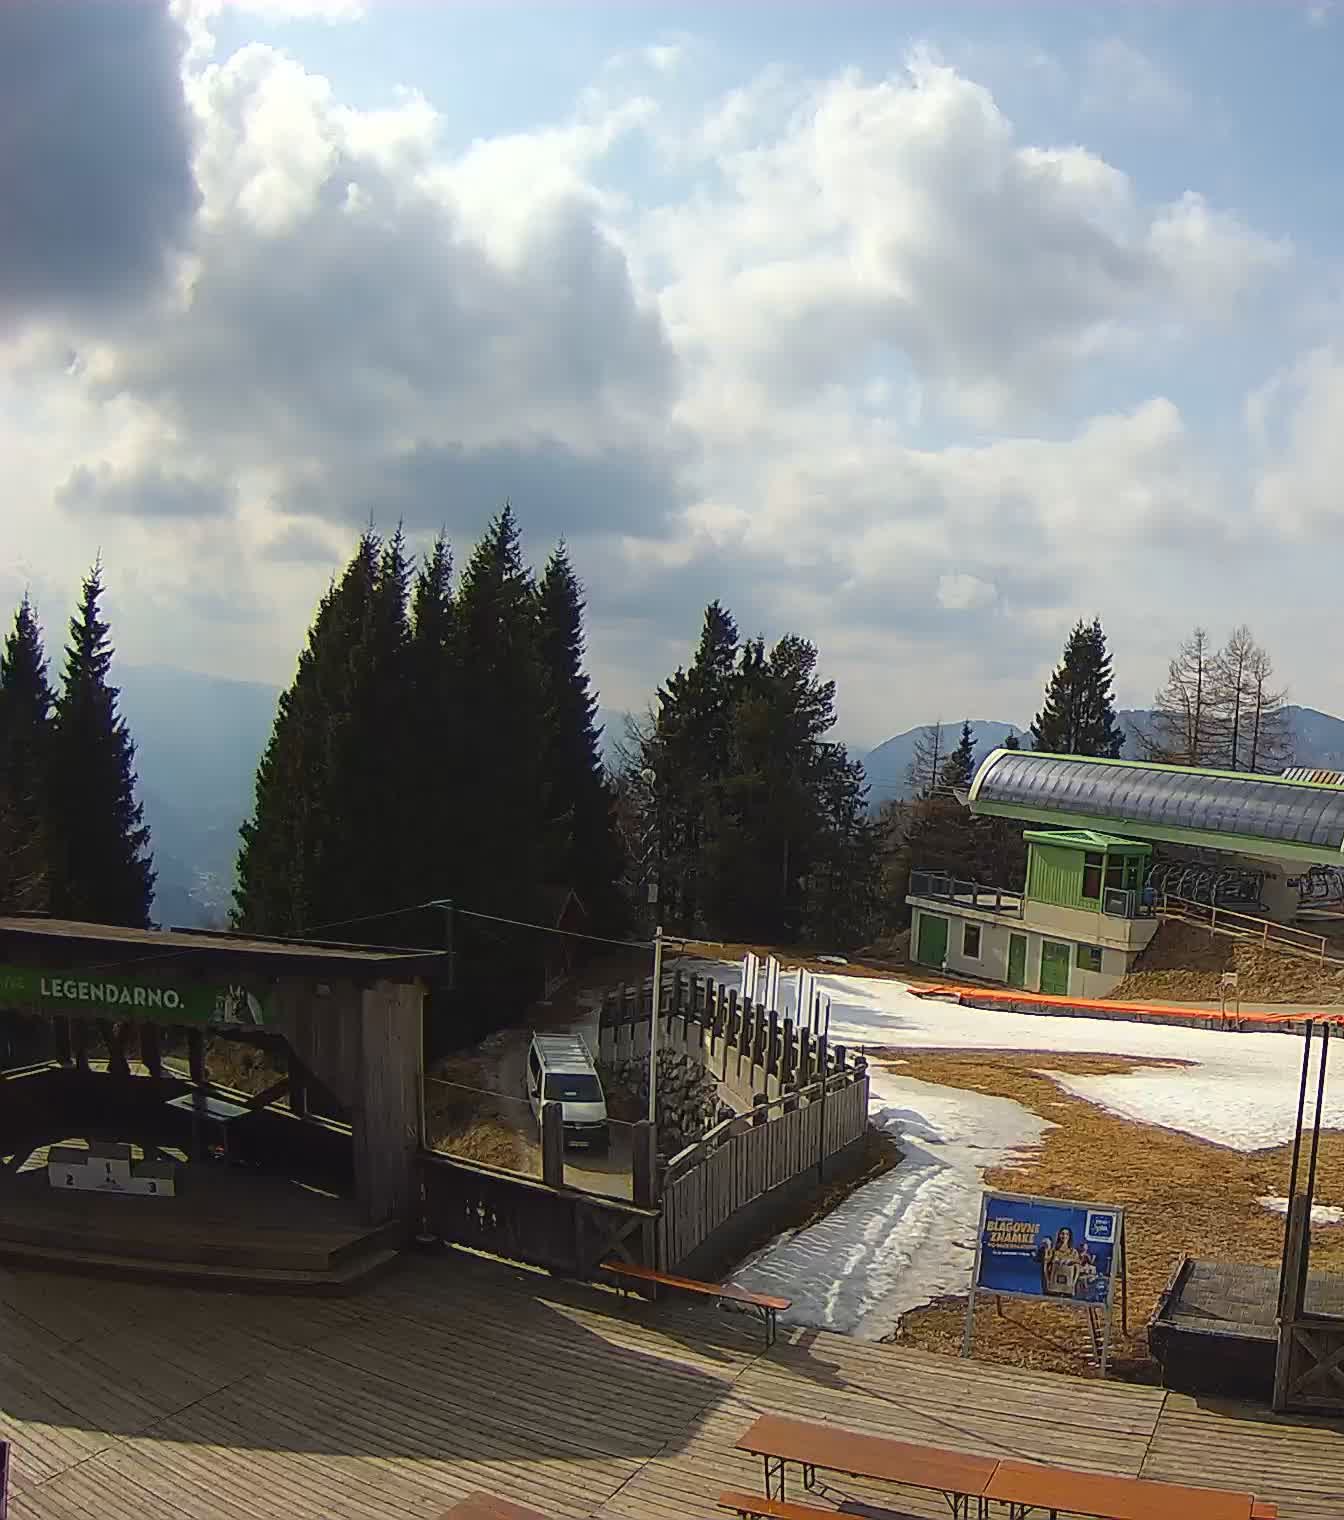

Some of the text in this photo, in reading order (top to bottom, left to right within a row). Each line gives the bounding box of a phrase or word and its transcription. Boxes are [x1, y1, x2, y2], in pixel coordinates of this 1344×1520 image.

[40, 977, 185, 1009] LEGENDARNO.
[66, 1174, 74, 1186] 2
[147, 1181, 157, 1194] 3
[986, 1220, 1041, 1234] BLAGOVNE
[991, 1231, 1036, 1243] ZNAMKE
